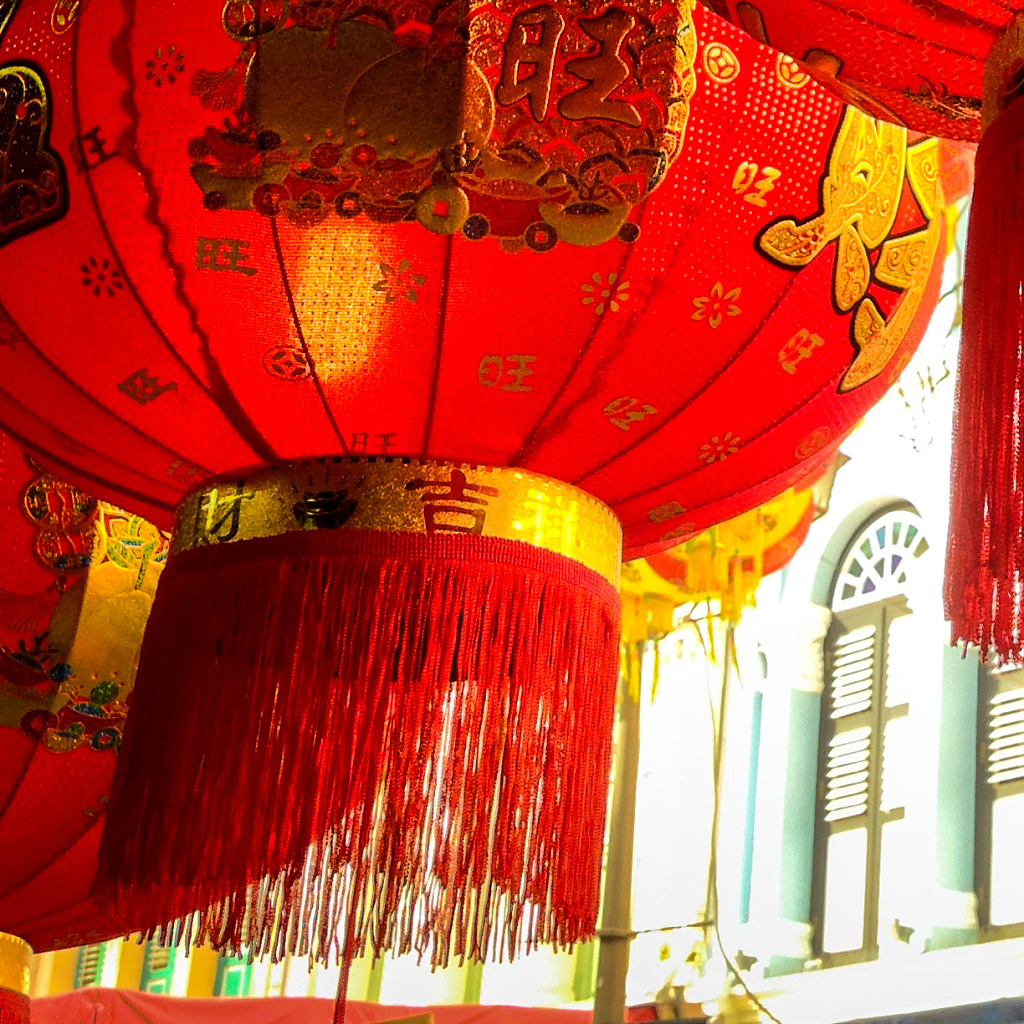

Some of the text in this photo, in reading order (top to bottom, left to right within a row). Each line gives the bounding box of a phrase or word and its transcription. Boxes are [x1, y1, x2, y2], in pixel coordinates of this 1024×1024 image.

[494, 2, 645, 128] 旺
[70, 126, 121, 175] 旺
[732, 160, 782, 209] 旺
[195, 236, 258, 277] 旺
[477, 353, 537, 393] 旺
[776, 327, 825, 375] 旺
[602, 395, 658, 432] 旺
